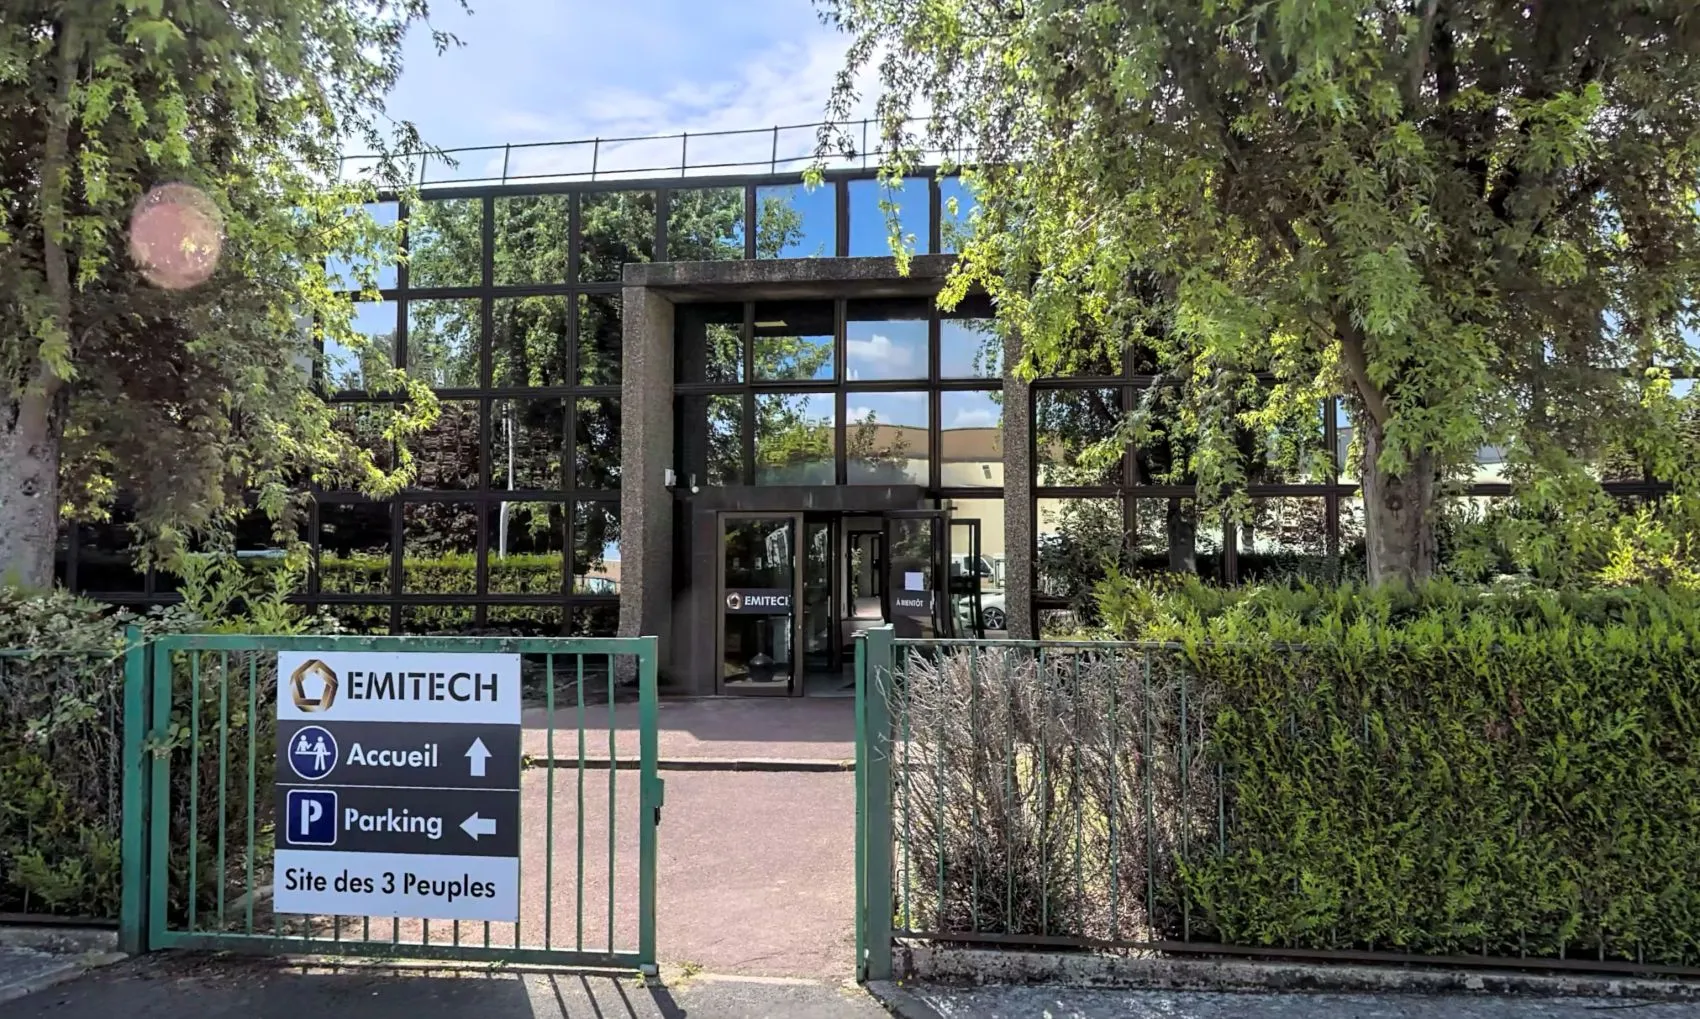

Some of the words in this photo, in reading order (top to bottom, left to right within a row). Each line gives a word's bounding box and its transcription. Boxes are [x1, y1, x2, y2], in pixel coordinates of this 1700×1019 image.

[347, 671, 498, 702] EMITECH
[346, 742, 438, 768] Accueil
[300, 799, 323, 836] P
[344, 807, 443, 840] Parking
[285, 867, 327, 892] Site
[334, 869, 374, 894] des
[382, 871, 395, 894] 3
[404, 872, 496, 903] Peuples
